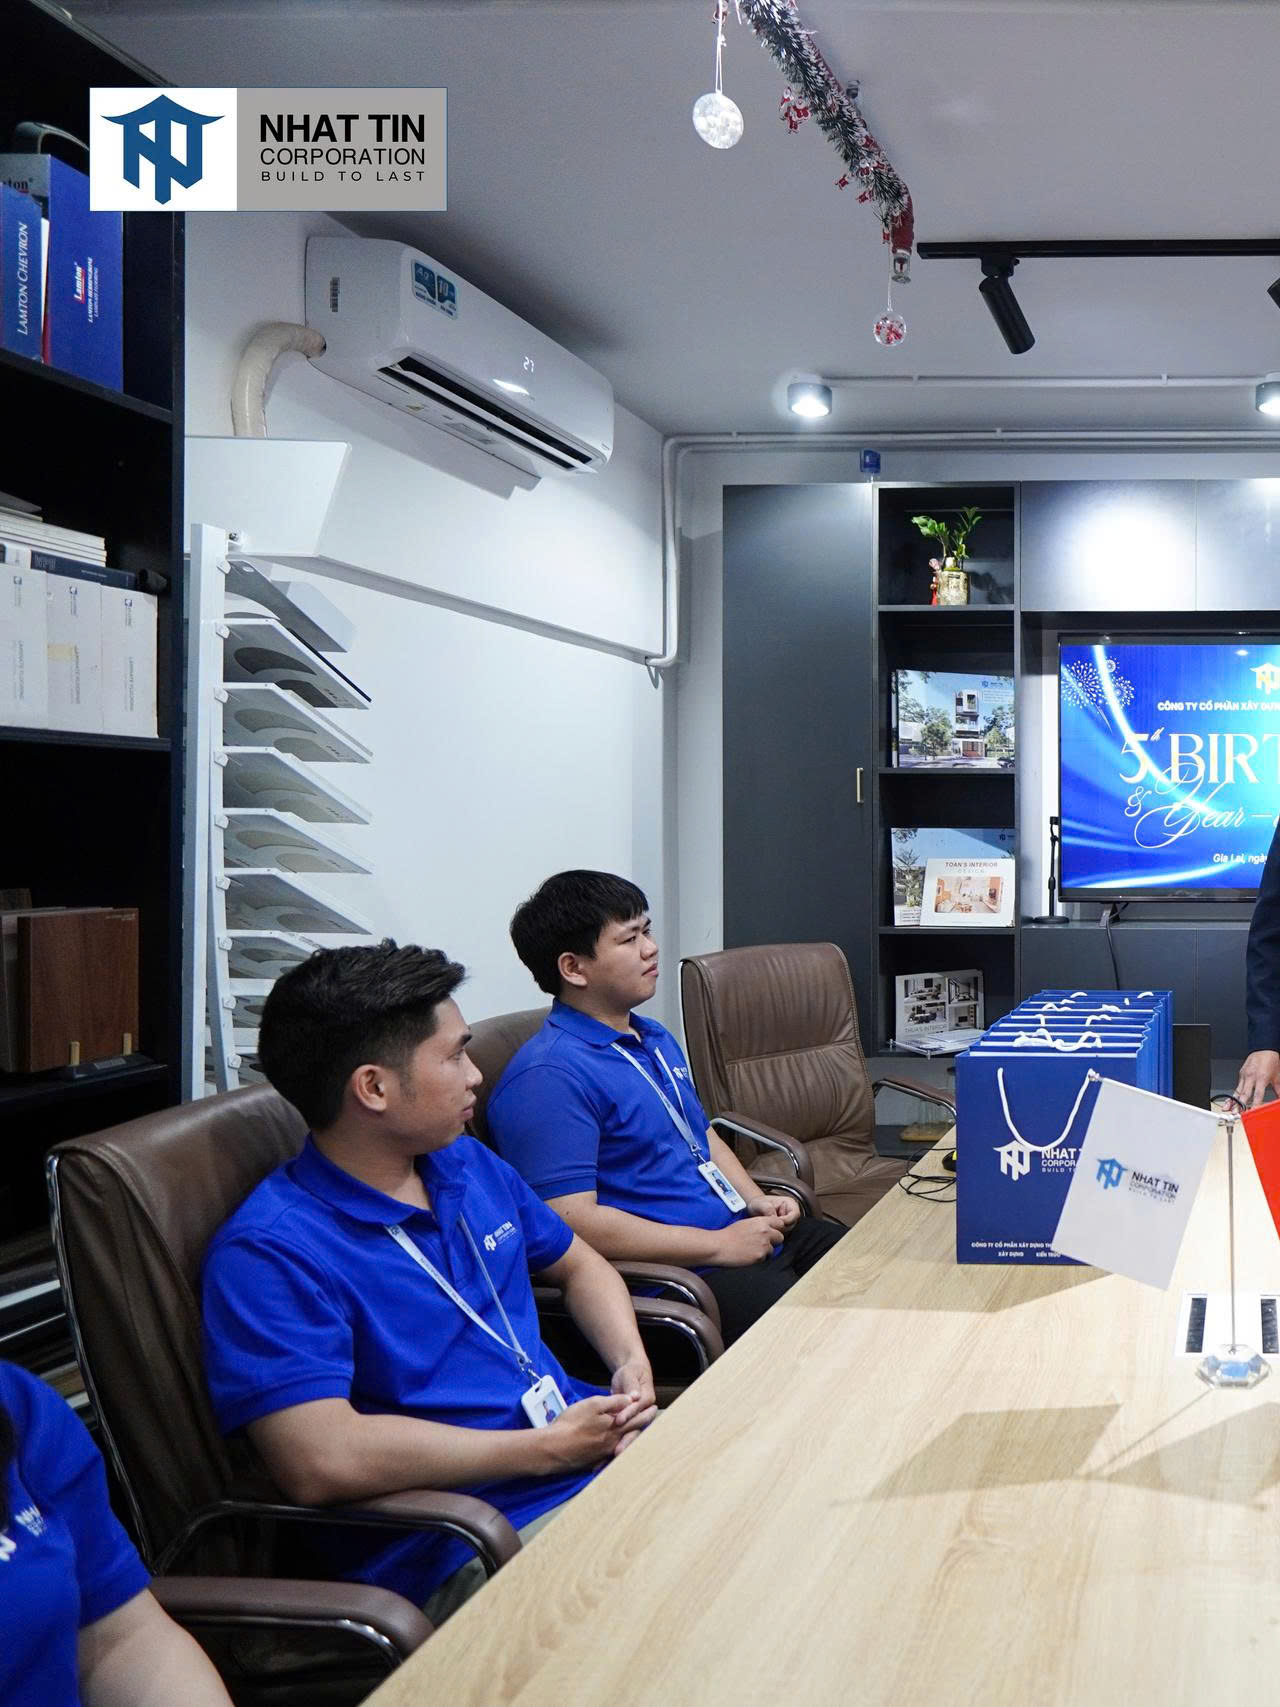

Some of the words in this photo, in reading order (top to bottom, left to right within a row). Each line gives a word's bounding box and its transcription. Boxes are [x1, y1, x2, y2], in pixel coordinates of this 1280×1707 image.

[17, 221, 28, 282] CHEVRON
[74, 265, 82, 300] Lamton
[17, 282, 28, 336] LAMTON
[1157, 699, 1184, 711] CÔNG
[1185, 702, 1198, 711] TY
[1041, 1148, 1077, 1159] NHAT
[1131, 1171, 1161, 1187] NHAT
[1163, 1181, 1179, 1193] TIN
